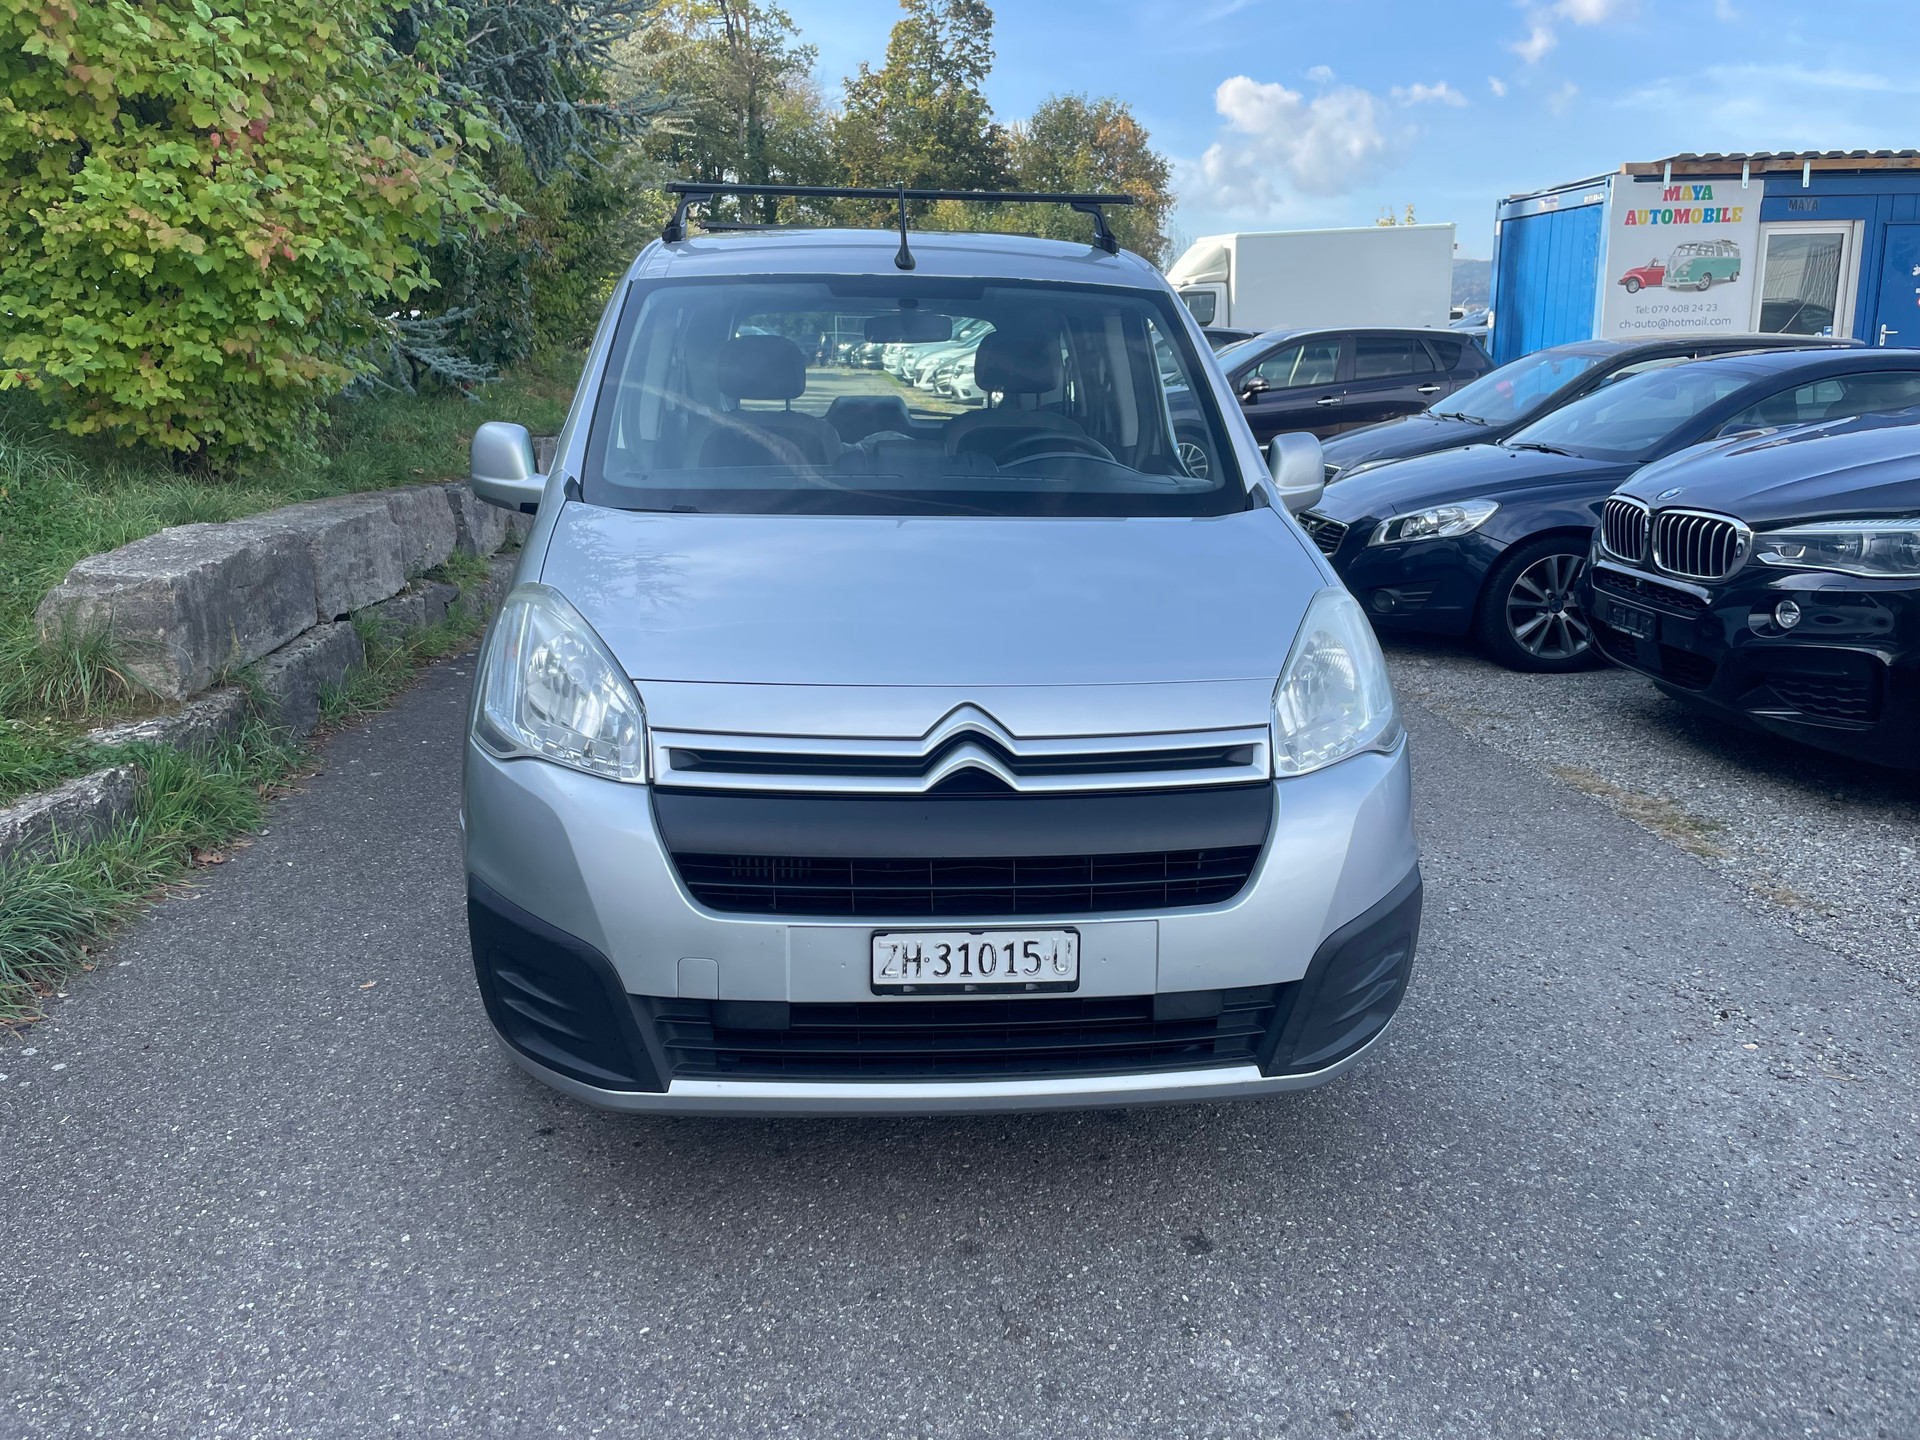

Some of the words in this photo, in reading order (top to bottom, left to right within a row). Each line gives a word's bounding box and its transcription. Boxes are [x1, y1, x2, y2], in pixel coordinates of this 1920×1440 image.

[1663, 185, 1713, 202] MAYA
[1789, 199, 1819, 211] MAYA
[1624, 207, 1744, 225] AUTOMOBILE
[1651, 305, 1669, 314] 079
[1671, 304, 1689, 313] 608
[1691, 304, 1703, 312] 24
[1706, 303, 1718, 312] 23
[1619, 317, 1732, 329] ch-auto@hotmail.com
